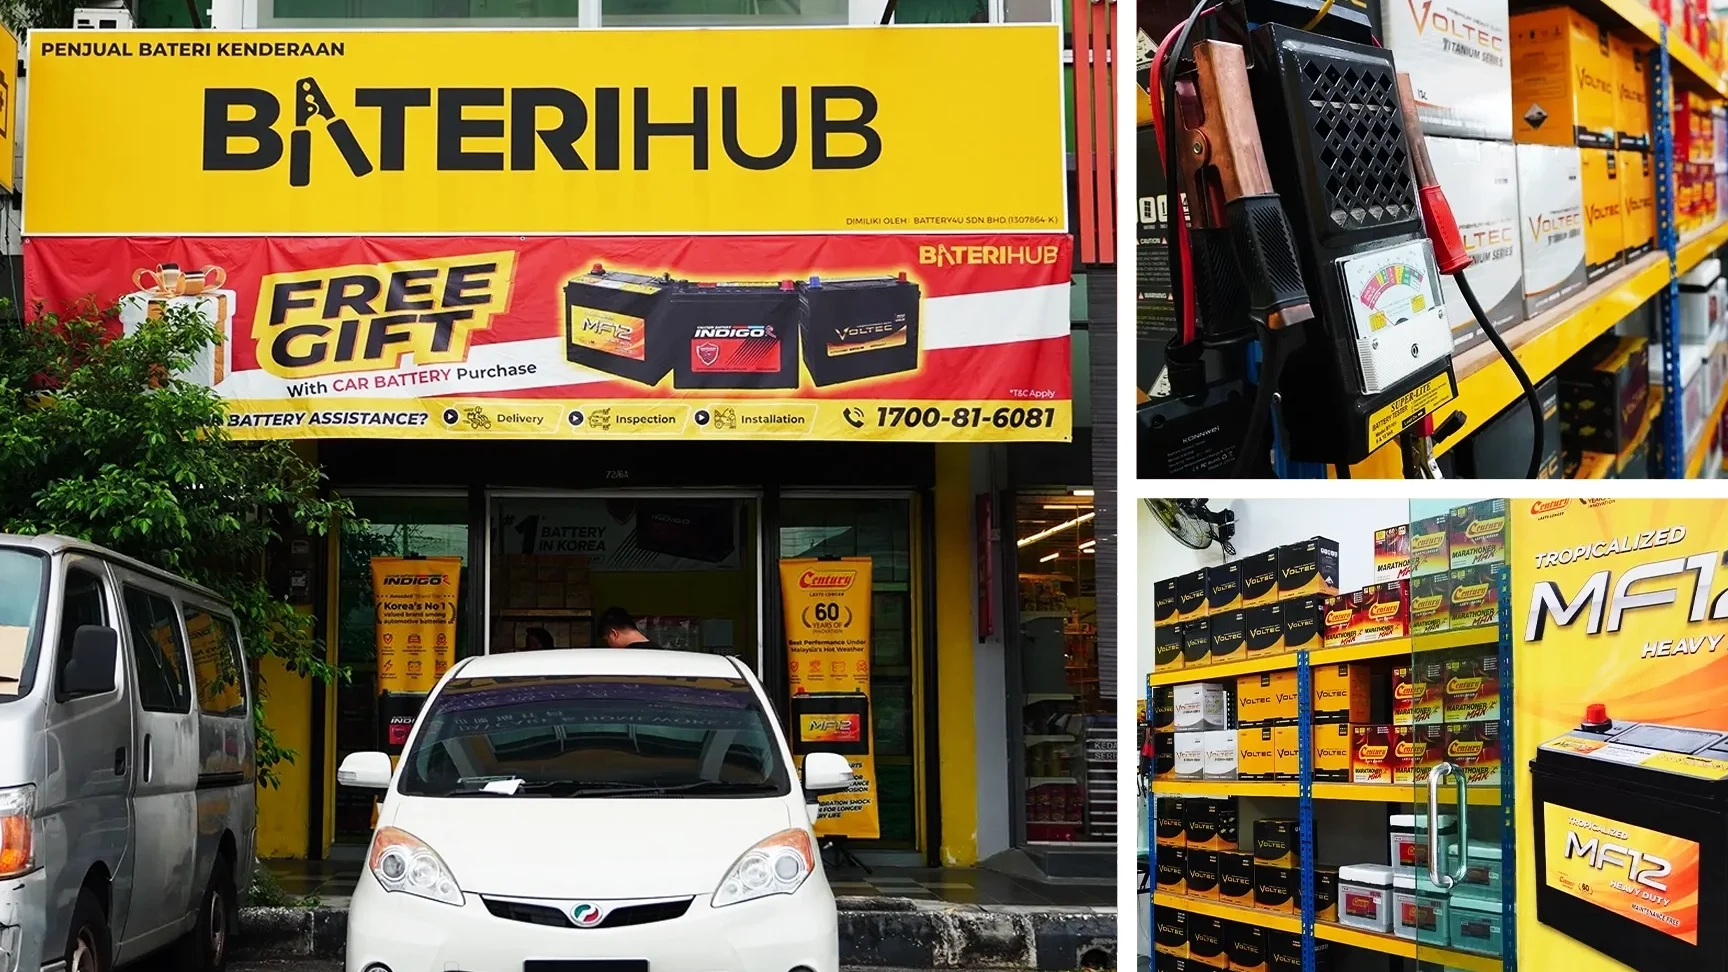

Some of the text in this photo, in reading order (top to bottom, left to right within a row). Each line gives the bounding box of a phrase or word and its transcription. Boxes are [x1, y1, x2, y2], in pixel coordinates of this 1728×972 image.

[1407, 0, 1503, 52] VOLTEC
[41, 42, 345, 57] PENJUAL BATERI KENDERAAN
[1442, 38, 1480, 60] TITANIUM
[202, 77, 883, 187] BATERIHUB
[846, 217, 882, 226] DIMILIKI
[913, 216, 964, 225] BATTERY4U
[966, 216, 985, 224] SDN
[987, 216, 1007, 224] BHD
[1528, 212, 1581, 242] VOLTEC
[1462, 227, 1513, 252] LTEC
[919, 243, 1059, 268] BATERIHUB
[1492, 245, 1514, 261] SERIES
[268, 262, 496, 326] FREE
[582, 317, 633, 340] MF12
[694, 328, 764, 338] INDIGO
[834, 324, 893, 341] VOLTEC
[271, 309, 474, 367] GIFT
[286, 362, 537, 399] With CAR BATTERY Purchase
[1030, 388, 1056, 399] Apply
[1391, 382, 1432, 413] SUPER-LITE
[227, 412, 306, 427] BATTERY
[308, 412, 429, 427] ASSISTANCE?
[496, 413, 544, 426] Delivery
[615, 414, 676, 426] Inspection
[741, 414, 805, 424] Installation
[876, 405, 1055, 428] 1700-81-6081
[1372, 414, 1392, 432] BATTERY
[1530, 497, 1570, 515] Century
[541, 526, 607, 538] BATTERY
[1468, 522, 1504, 536] Century
[539, 539, 607, 552] IN KOREA
[1535, 525, 1687, 569] TROPICALIZED
[1281, 564, 1316, 578] VOLTEC
[383, 577, 442, 586] INDIGO
[799, 571, 852, 589] Century
[1245, 573, 1274, 588] VOLTEC
[1212, 582, 1237, 595] VOLTEC
[1454, 586, 1486, 600] Century
[1181, 590, 1204, 604] VOLTEC
[1524, 551, 1728, 642] MF1
[384, 602, 422, 611] Korea's
[425, 602, 439, 610] No
[815, 602, 840, 621] 60
[1249, 626, 1280, 638] VOLTEC
[1287, 620, 1314, 630] VOLTEC
[1187, 639, 1208, 648] VOLTEC
[1213, 633, 1242, 645] VOLTEC
[1156, 644, 1180, 654] VOLTEC
[1641, 634, 1725, 659] HEAVY
[1448, 680, 1480, 693] Century
[1240, 697, 1271, 707] VOLTEC
[1276, 693, 1297, 704] VOLT
[1316, 690, 1347, 700] VOLTEC
[1240, 749, 1272, 759] VOLTEC
[1277, 749, 1298, 758] VOLT
[1316, 748, 1347, 758] VOLTEC
[1448, 743, 1481, 755] Century
[1158, 818, 1182, 827] VOLTEC
[1189, 821, 1215, 830] VOLTEC
[1568, 816, 1629, 841] TROPICALIZED
[1257, 839, 1286, 849] VOLTEC
[1564, 830, 1673, 893] MF12
[1158, 864, 1182, 875] VOLTEC
[1189, 869, 1215, 880] VOLTEC
[1221, 874, 1250, 885] VOLTEC
[1259, 884, 1287, 895] VOLTEC
[1610, 880, 1671, 907] HEAVY DUTY
[1631, 903, 1680, 927] MAINTENANCE FREE
[1157, 922, 1184, 936] VOLTEC
[1194, 933, 1218, 944] VOLTEC
[1233, 941, 1259, 954] VOLTEC
[1273, 952, 1301, 966] VOLTEC
